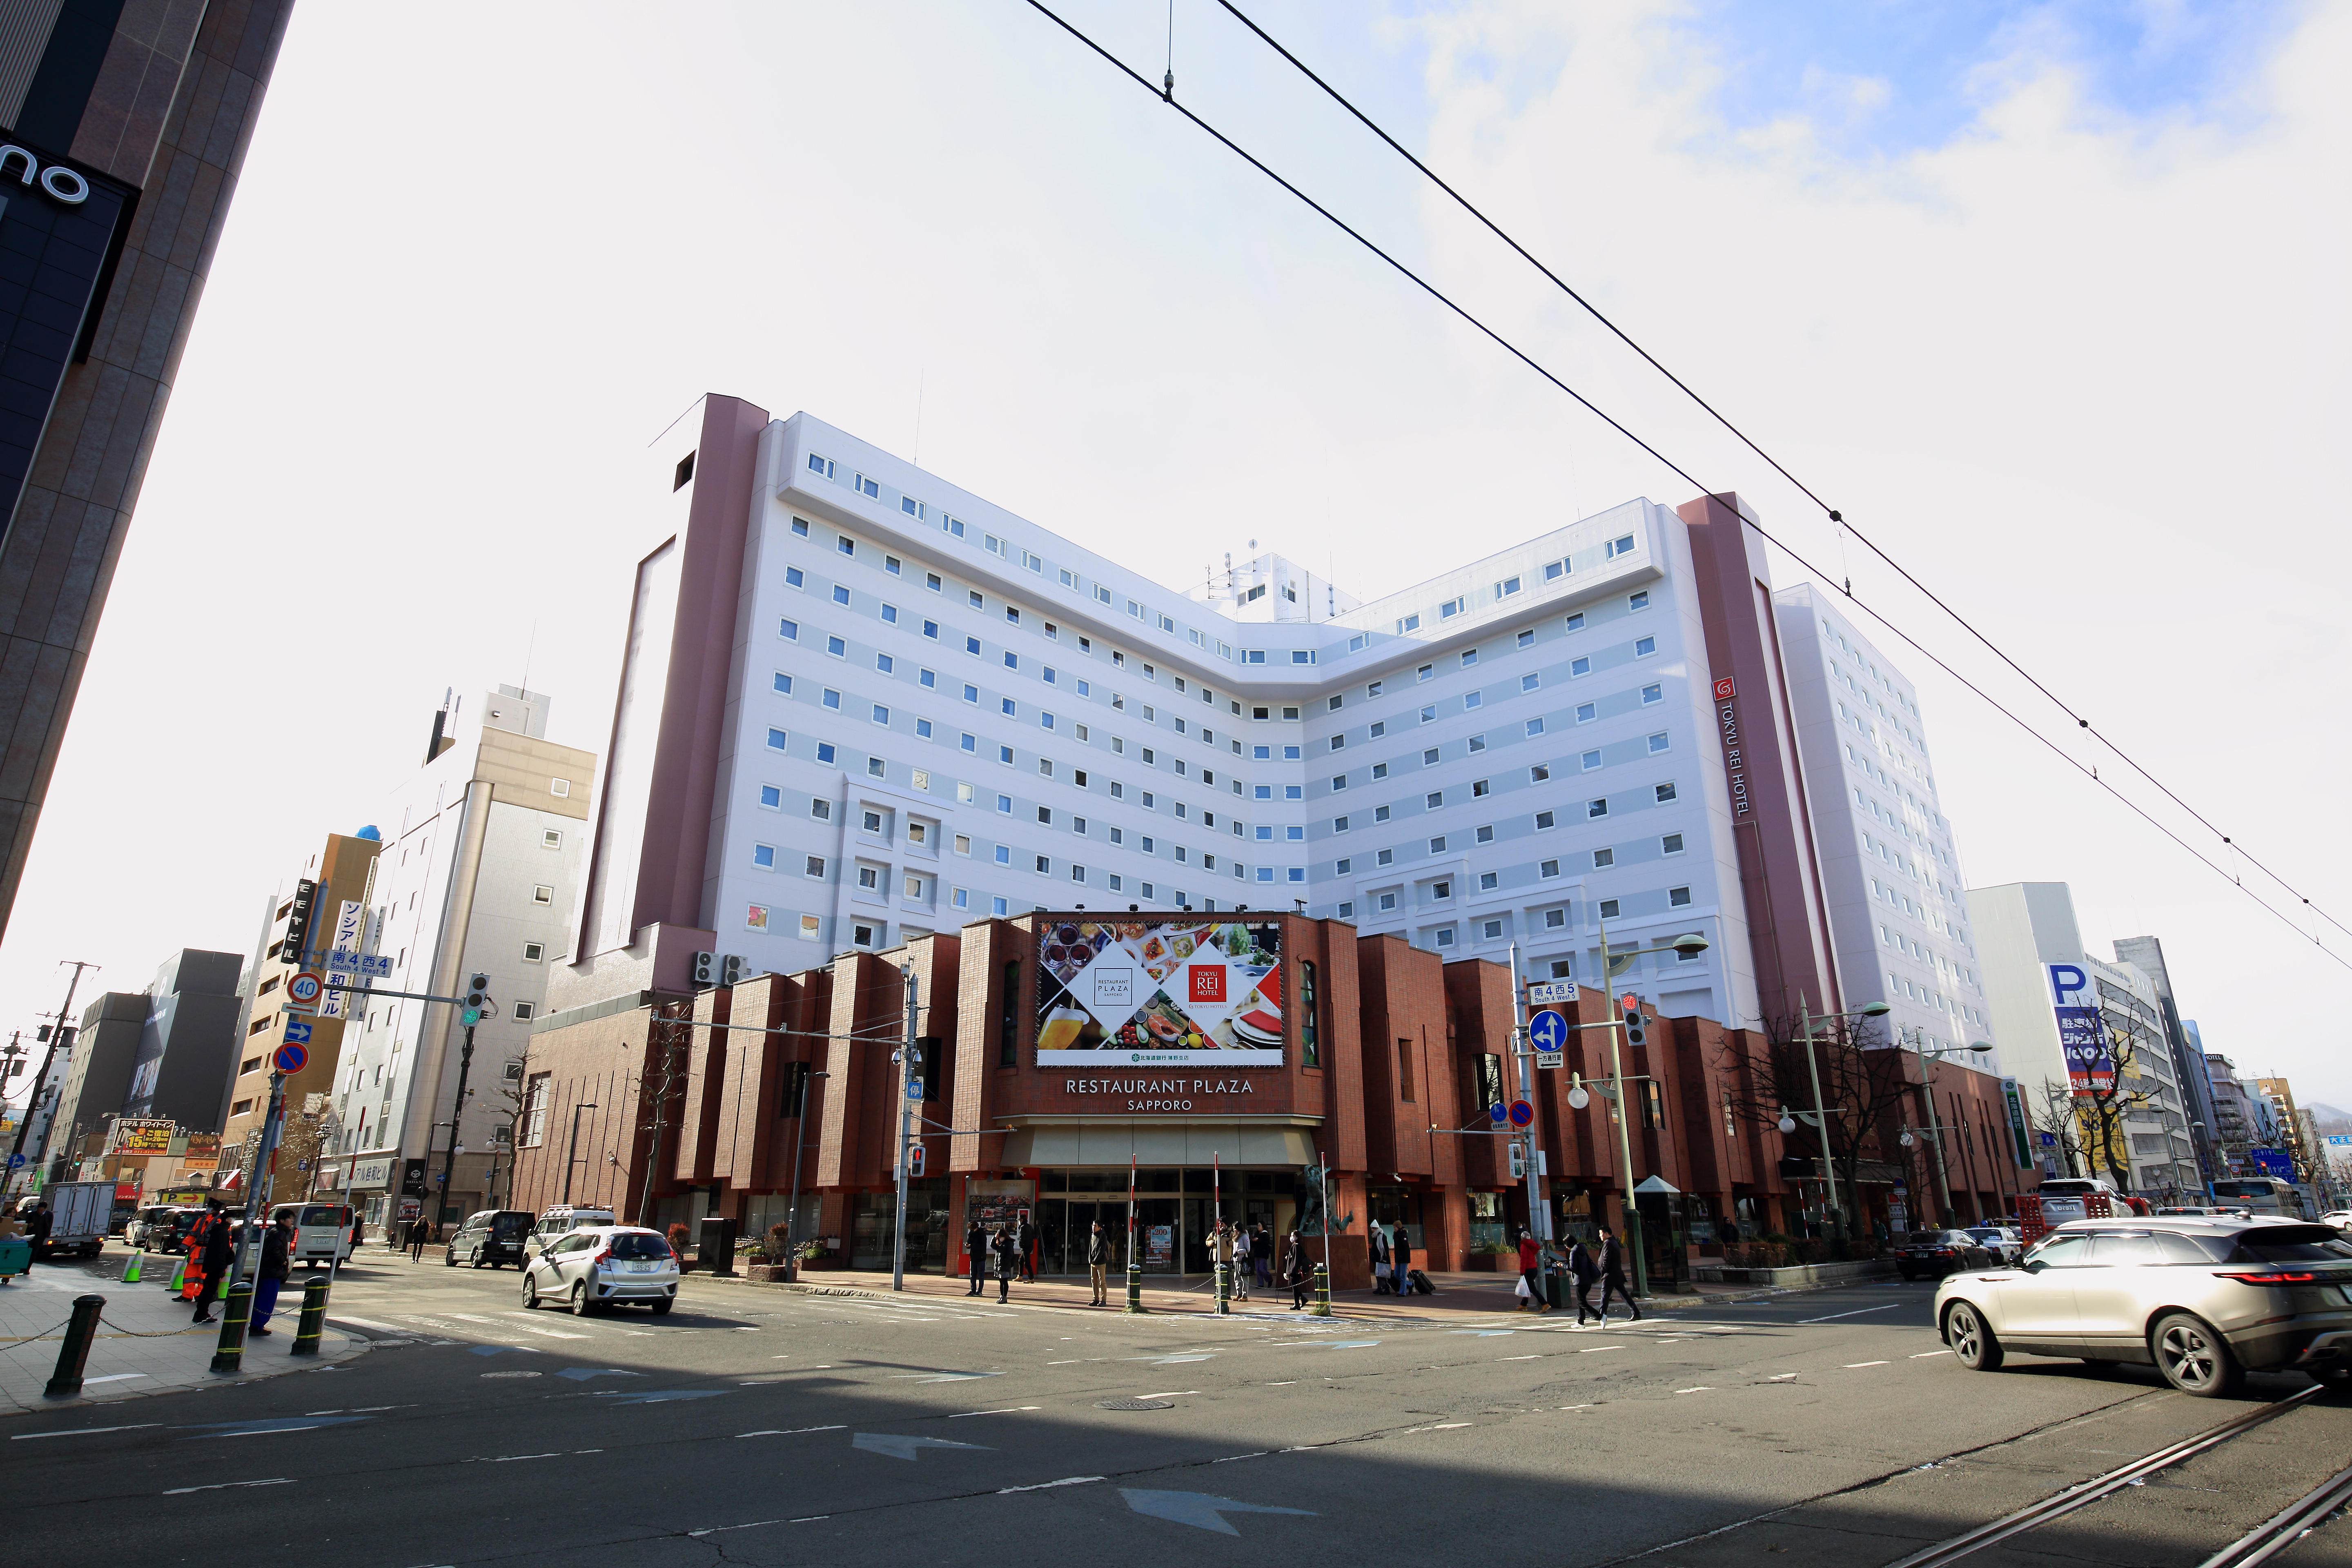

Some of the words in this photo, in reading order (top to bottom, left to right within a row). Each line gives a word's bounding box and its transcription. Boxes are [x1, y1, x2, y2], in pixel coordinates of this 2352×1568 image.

[1722, 702, 1737, 745] TOKYU
[1728, 750, 1742, 770] REI
[1733, 774, 1749, 817] HOTEL
[283, 884, 310, 958] モモヤビル
[324, 903, 360, 1014] ソシア和ビル
[331, 962, 351, 971] South
[295, 981, 315, 996] 40
[1197, 977, 1218, 989] REI
[2049, 965, 2086, 1004] P
[910, 1085, 920, 1096] 停
[1067, 1080, 1186, 1093] RESTAURANT
[1194, 1080, 1253, 1093] PLAZA
[1128, 1100, 1192, 1110] SAPPORO
[2009, 1097, 2022, 1129] 北海道銀行
[167, 1194, 178, 1203] P
